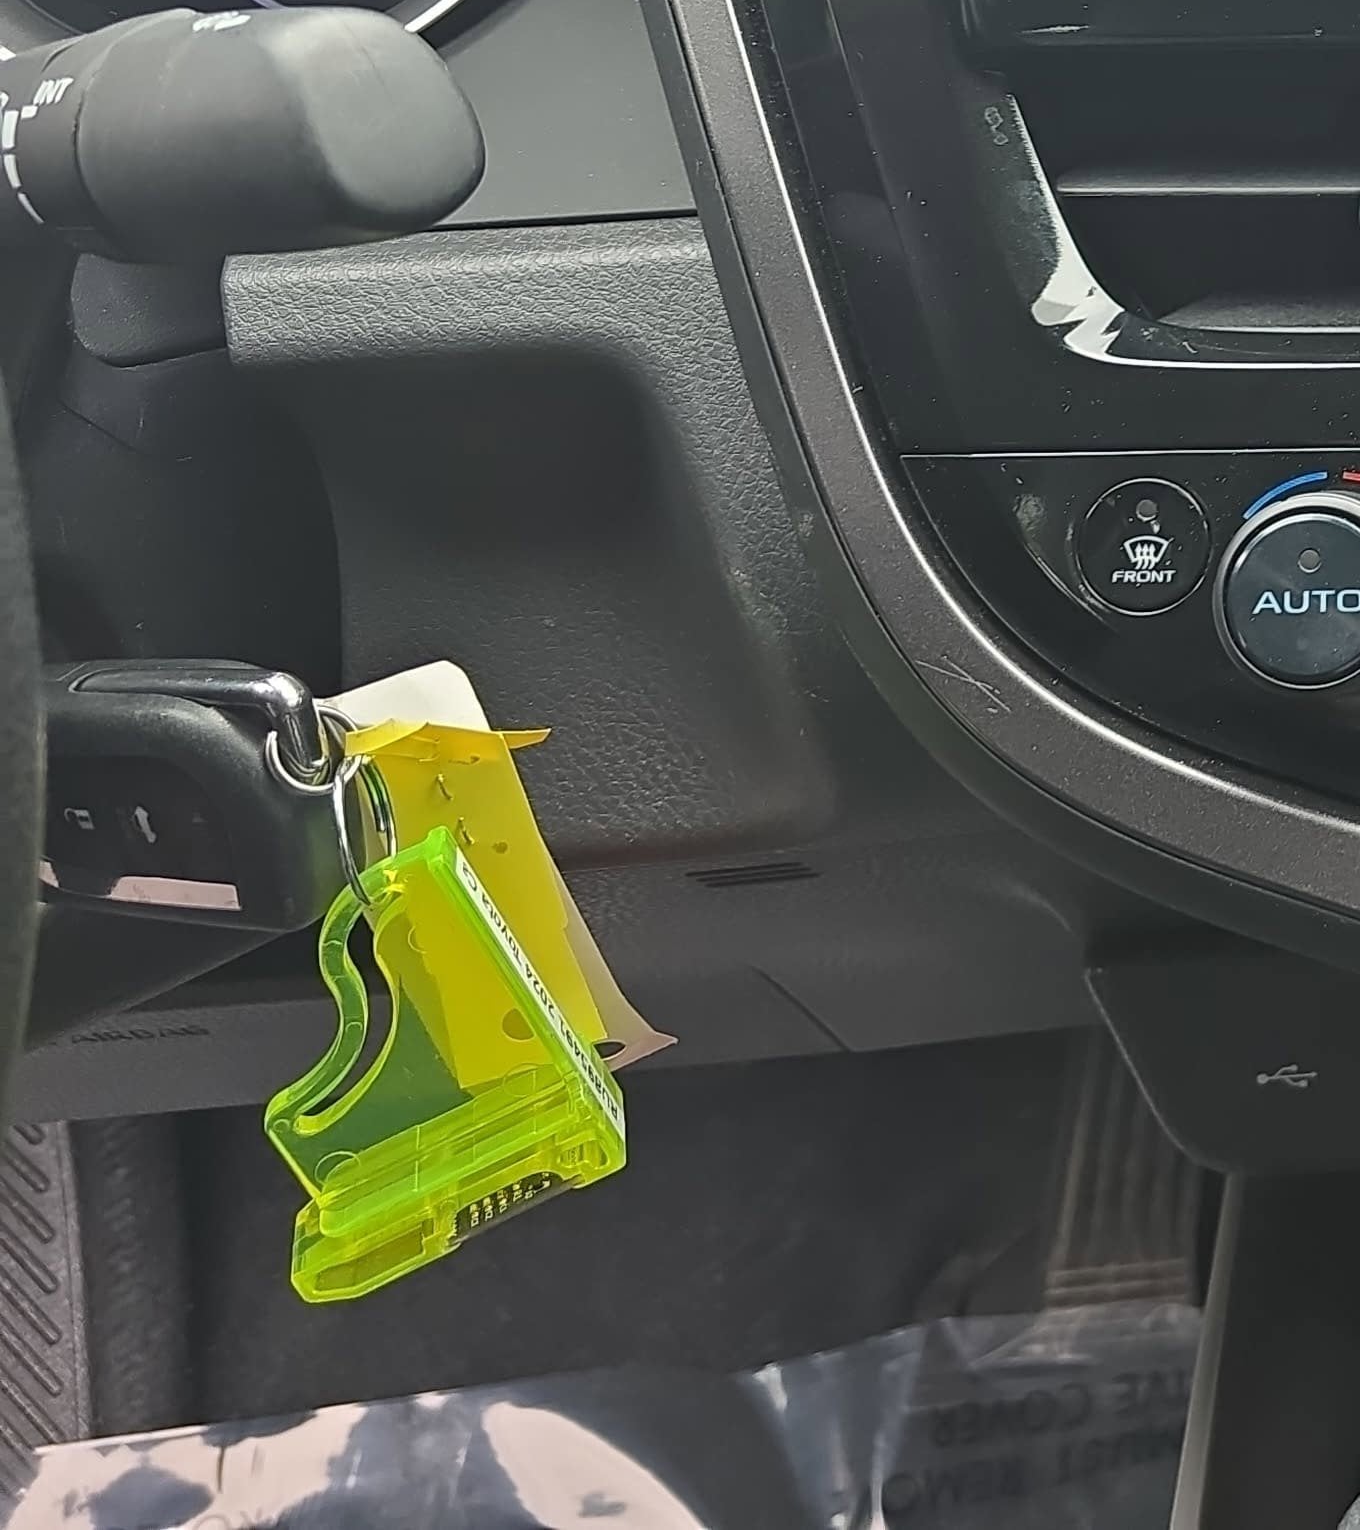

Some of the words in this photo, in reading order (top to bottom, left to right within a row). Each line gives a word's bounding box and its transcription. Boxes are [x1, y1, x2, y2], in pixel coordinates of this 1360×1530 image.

[1111, 569, 1176, 585] FRONT
[482, 892, 522, 966] Toyota
[524, 964, 555, 1016] 2024
